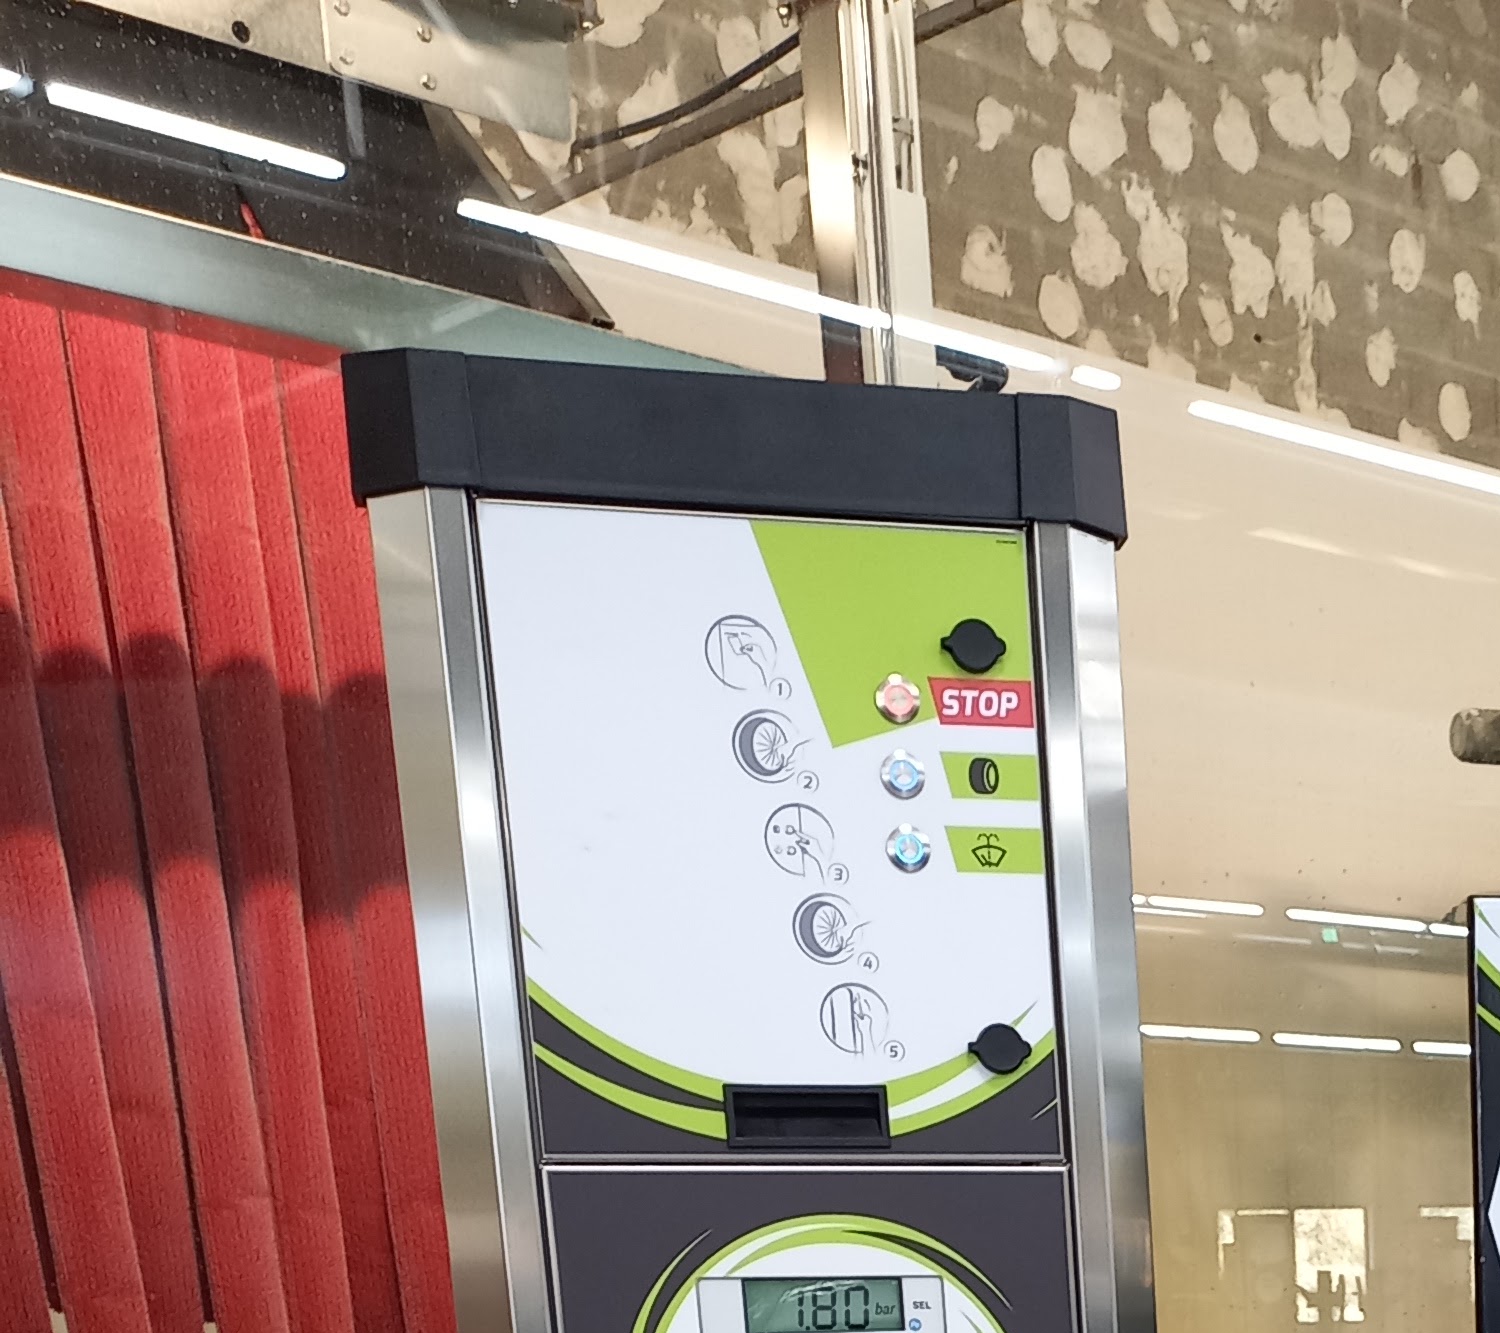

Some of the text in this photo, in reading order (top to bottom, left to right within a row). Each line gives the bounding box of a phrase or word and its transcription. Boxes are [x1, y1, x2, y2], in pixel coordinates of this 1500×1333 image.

[940, 689, 1019, 718] STOP
[875, 1302, 896, 1316] bar
[912, 1301, 932, 1311] SEL
